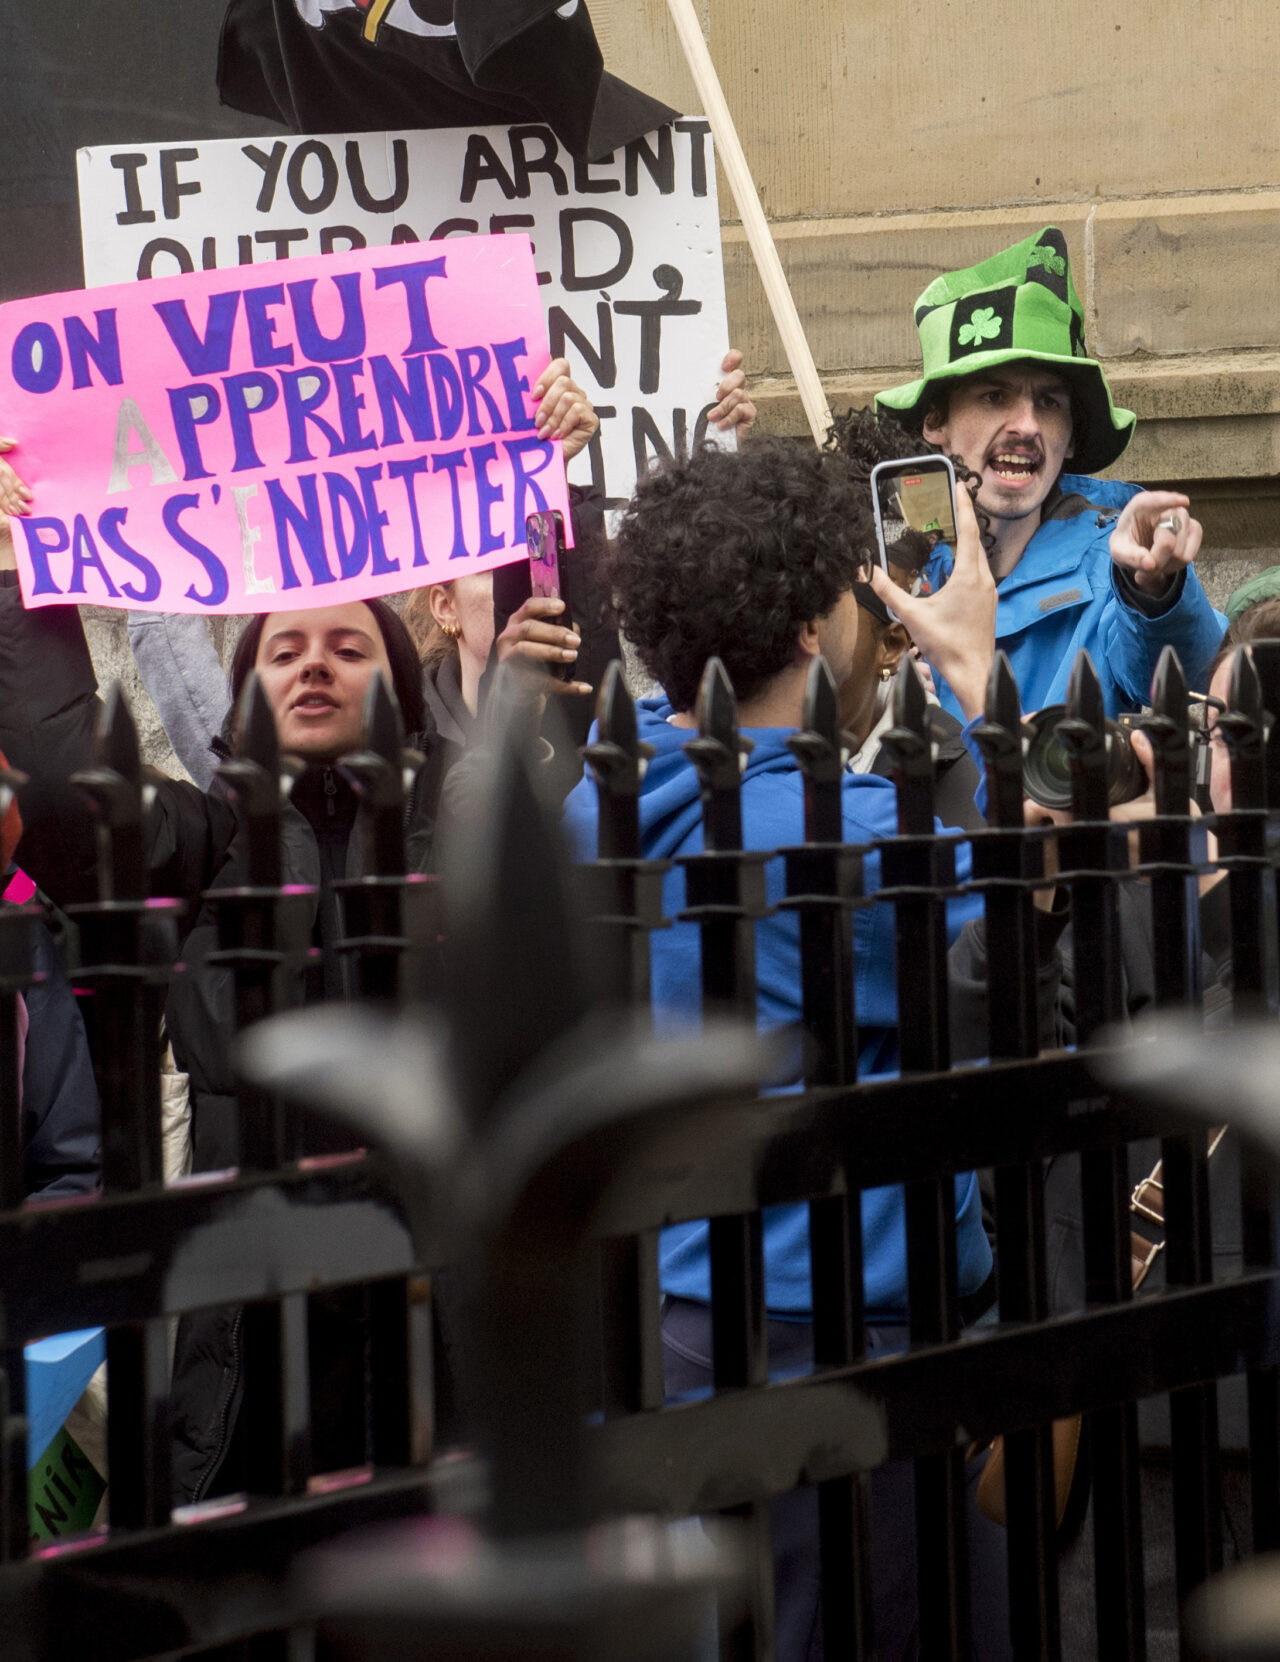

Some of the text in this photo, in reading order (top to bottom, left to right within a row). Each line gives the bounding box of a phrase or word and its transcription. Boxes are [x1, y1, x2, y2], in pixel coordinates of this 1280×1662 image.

[110, 147, 202, 226] IF
[241, 138, 410, 215] YOU
[11, 255, 448, 395] ON VEUT
[106, 336, 537, 495] APPRENDRE
[18, 435, 554, 607] PAS S'ENDETTER
